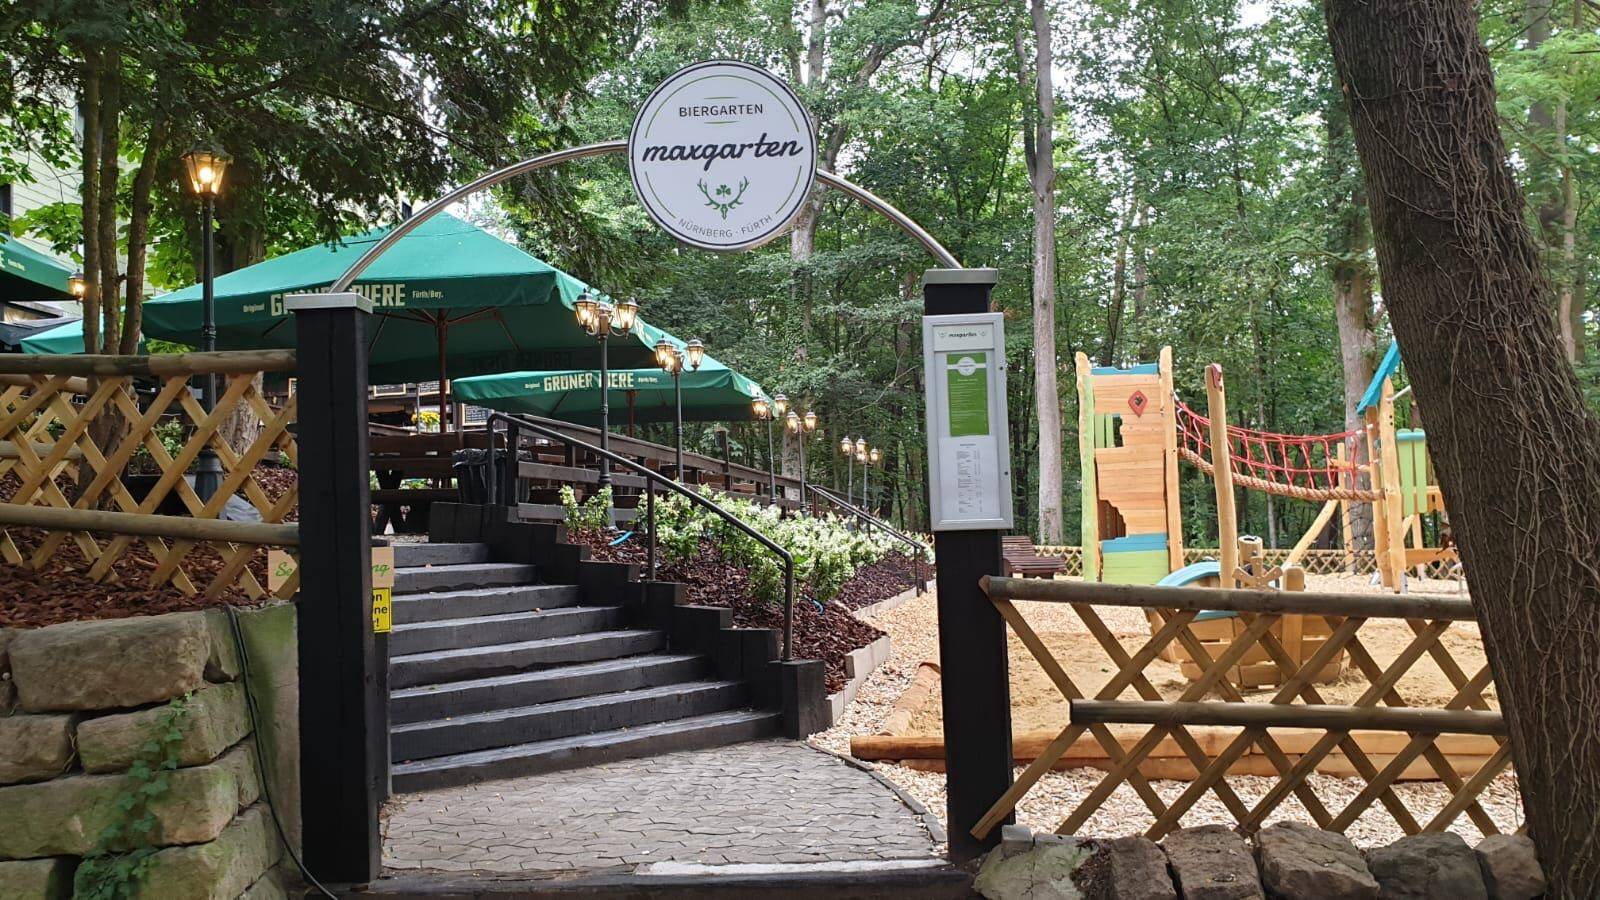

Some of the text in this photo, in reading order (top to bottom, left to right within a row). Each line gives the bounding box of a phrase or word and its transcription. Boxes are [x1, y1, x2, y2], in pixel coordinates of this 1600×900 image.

[679, 104, 763, 117] BIERGARTEN
[642, 132, 804, 171] maxgarten
[679, 215, 772, 238] NÜRNBERG FÜRTH
